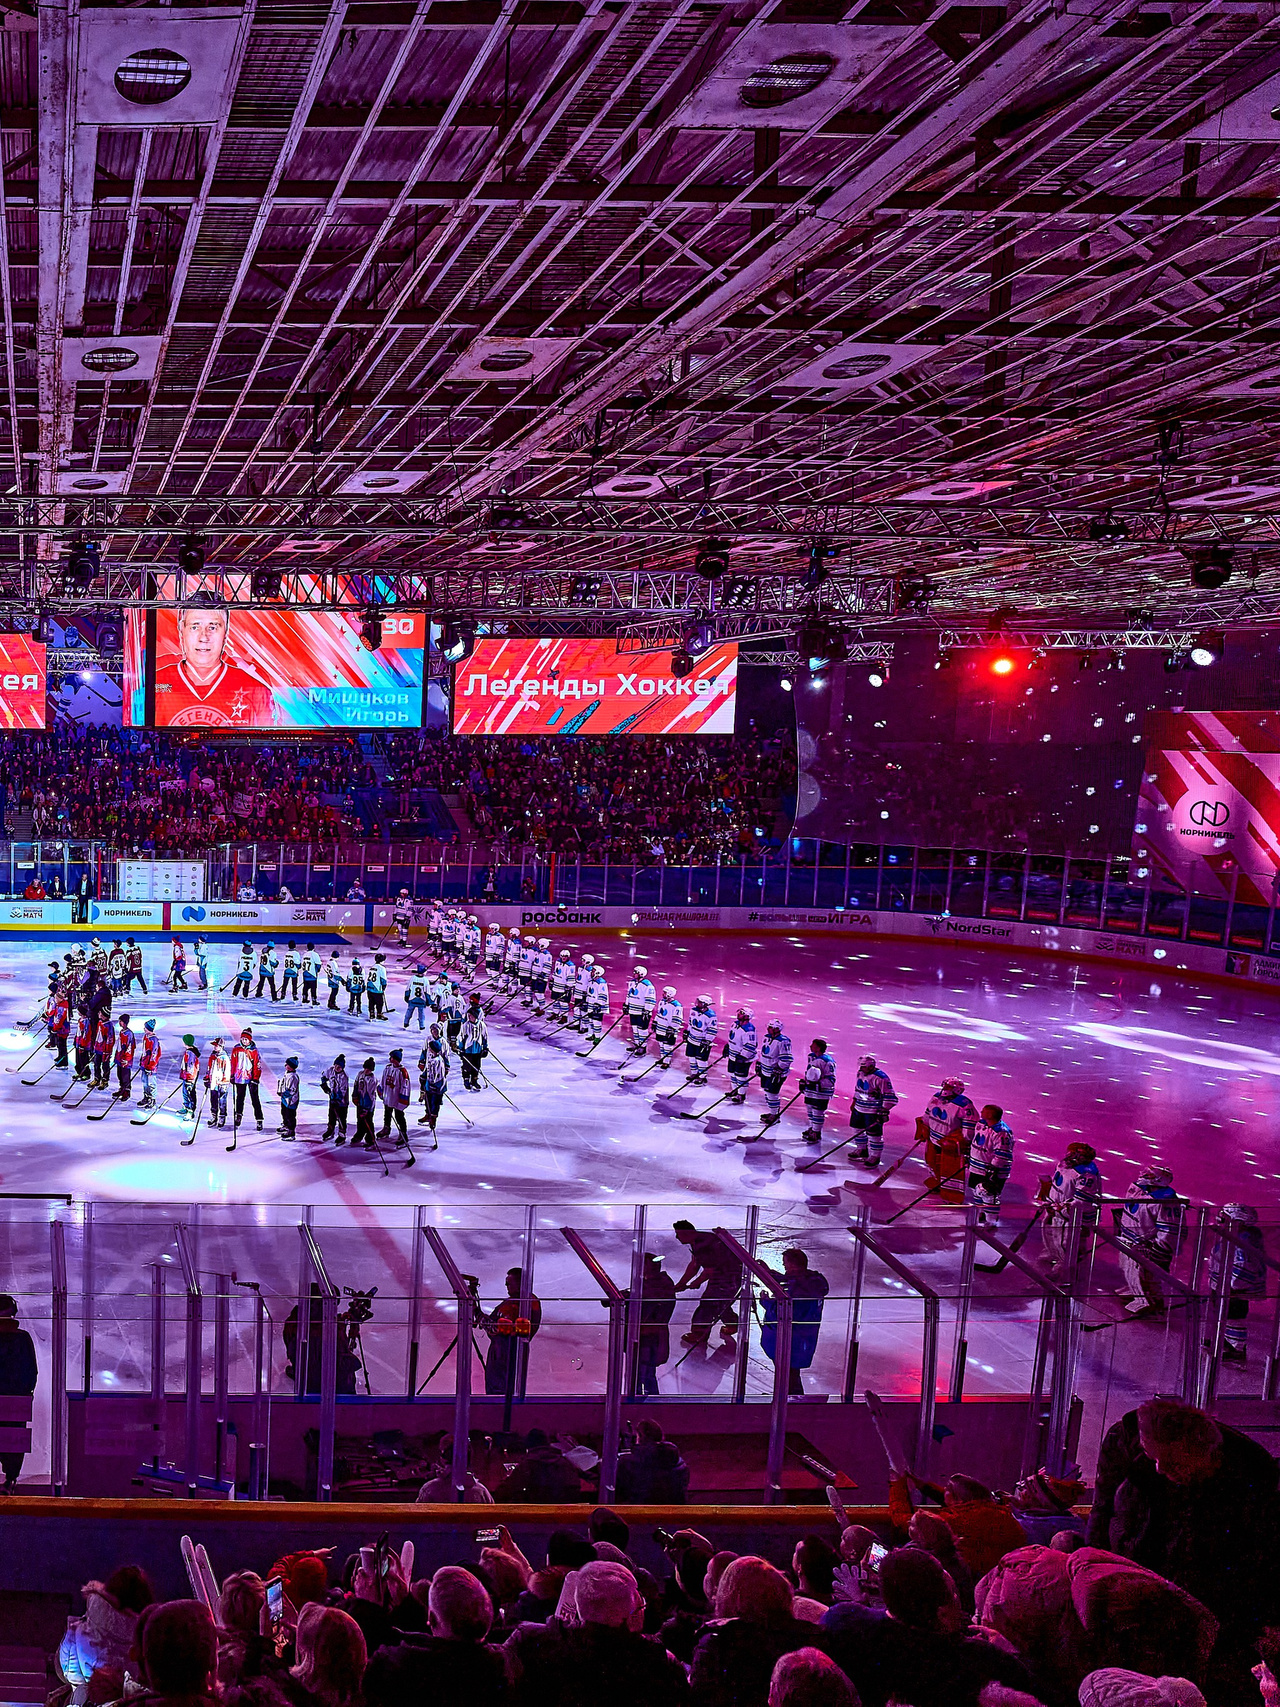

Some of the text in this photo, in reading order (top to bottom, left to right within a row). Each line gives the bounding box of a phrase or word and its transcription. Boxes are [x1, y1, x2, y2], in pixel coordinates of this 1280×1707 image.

[464, 673, 730, 699] Легенды Хоккея
[179, 711, 222, 726] ЕГЕНД
[345, 708, 409, 724] Игорь
[1180, 829, 1236, 840] НОРНИКЕЛЬ
[104, 909, 153, 917] НОРНИКЕЛЬ
[210, 910, 259, 918] НОРНИКЕЛЬ
[521, 907, 602, 925] росбанк
[946, 921, 1012, 938] NordStar
[243, 961, 250, 972] 3
